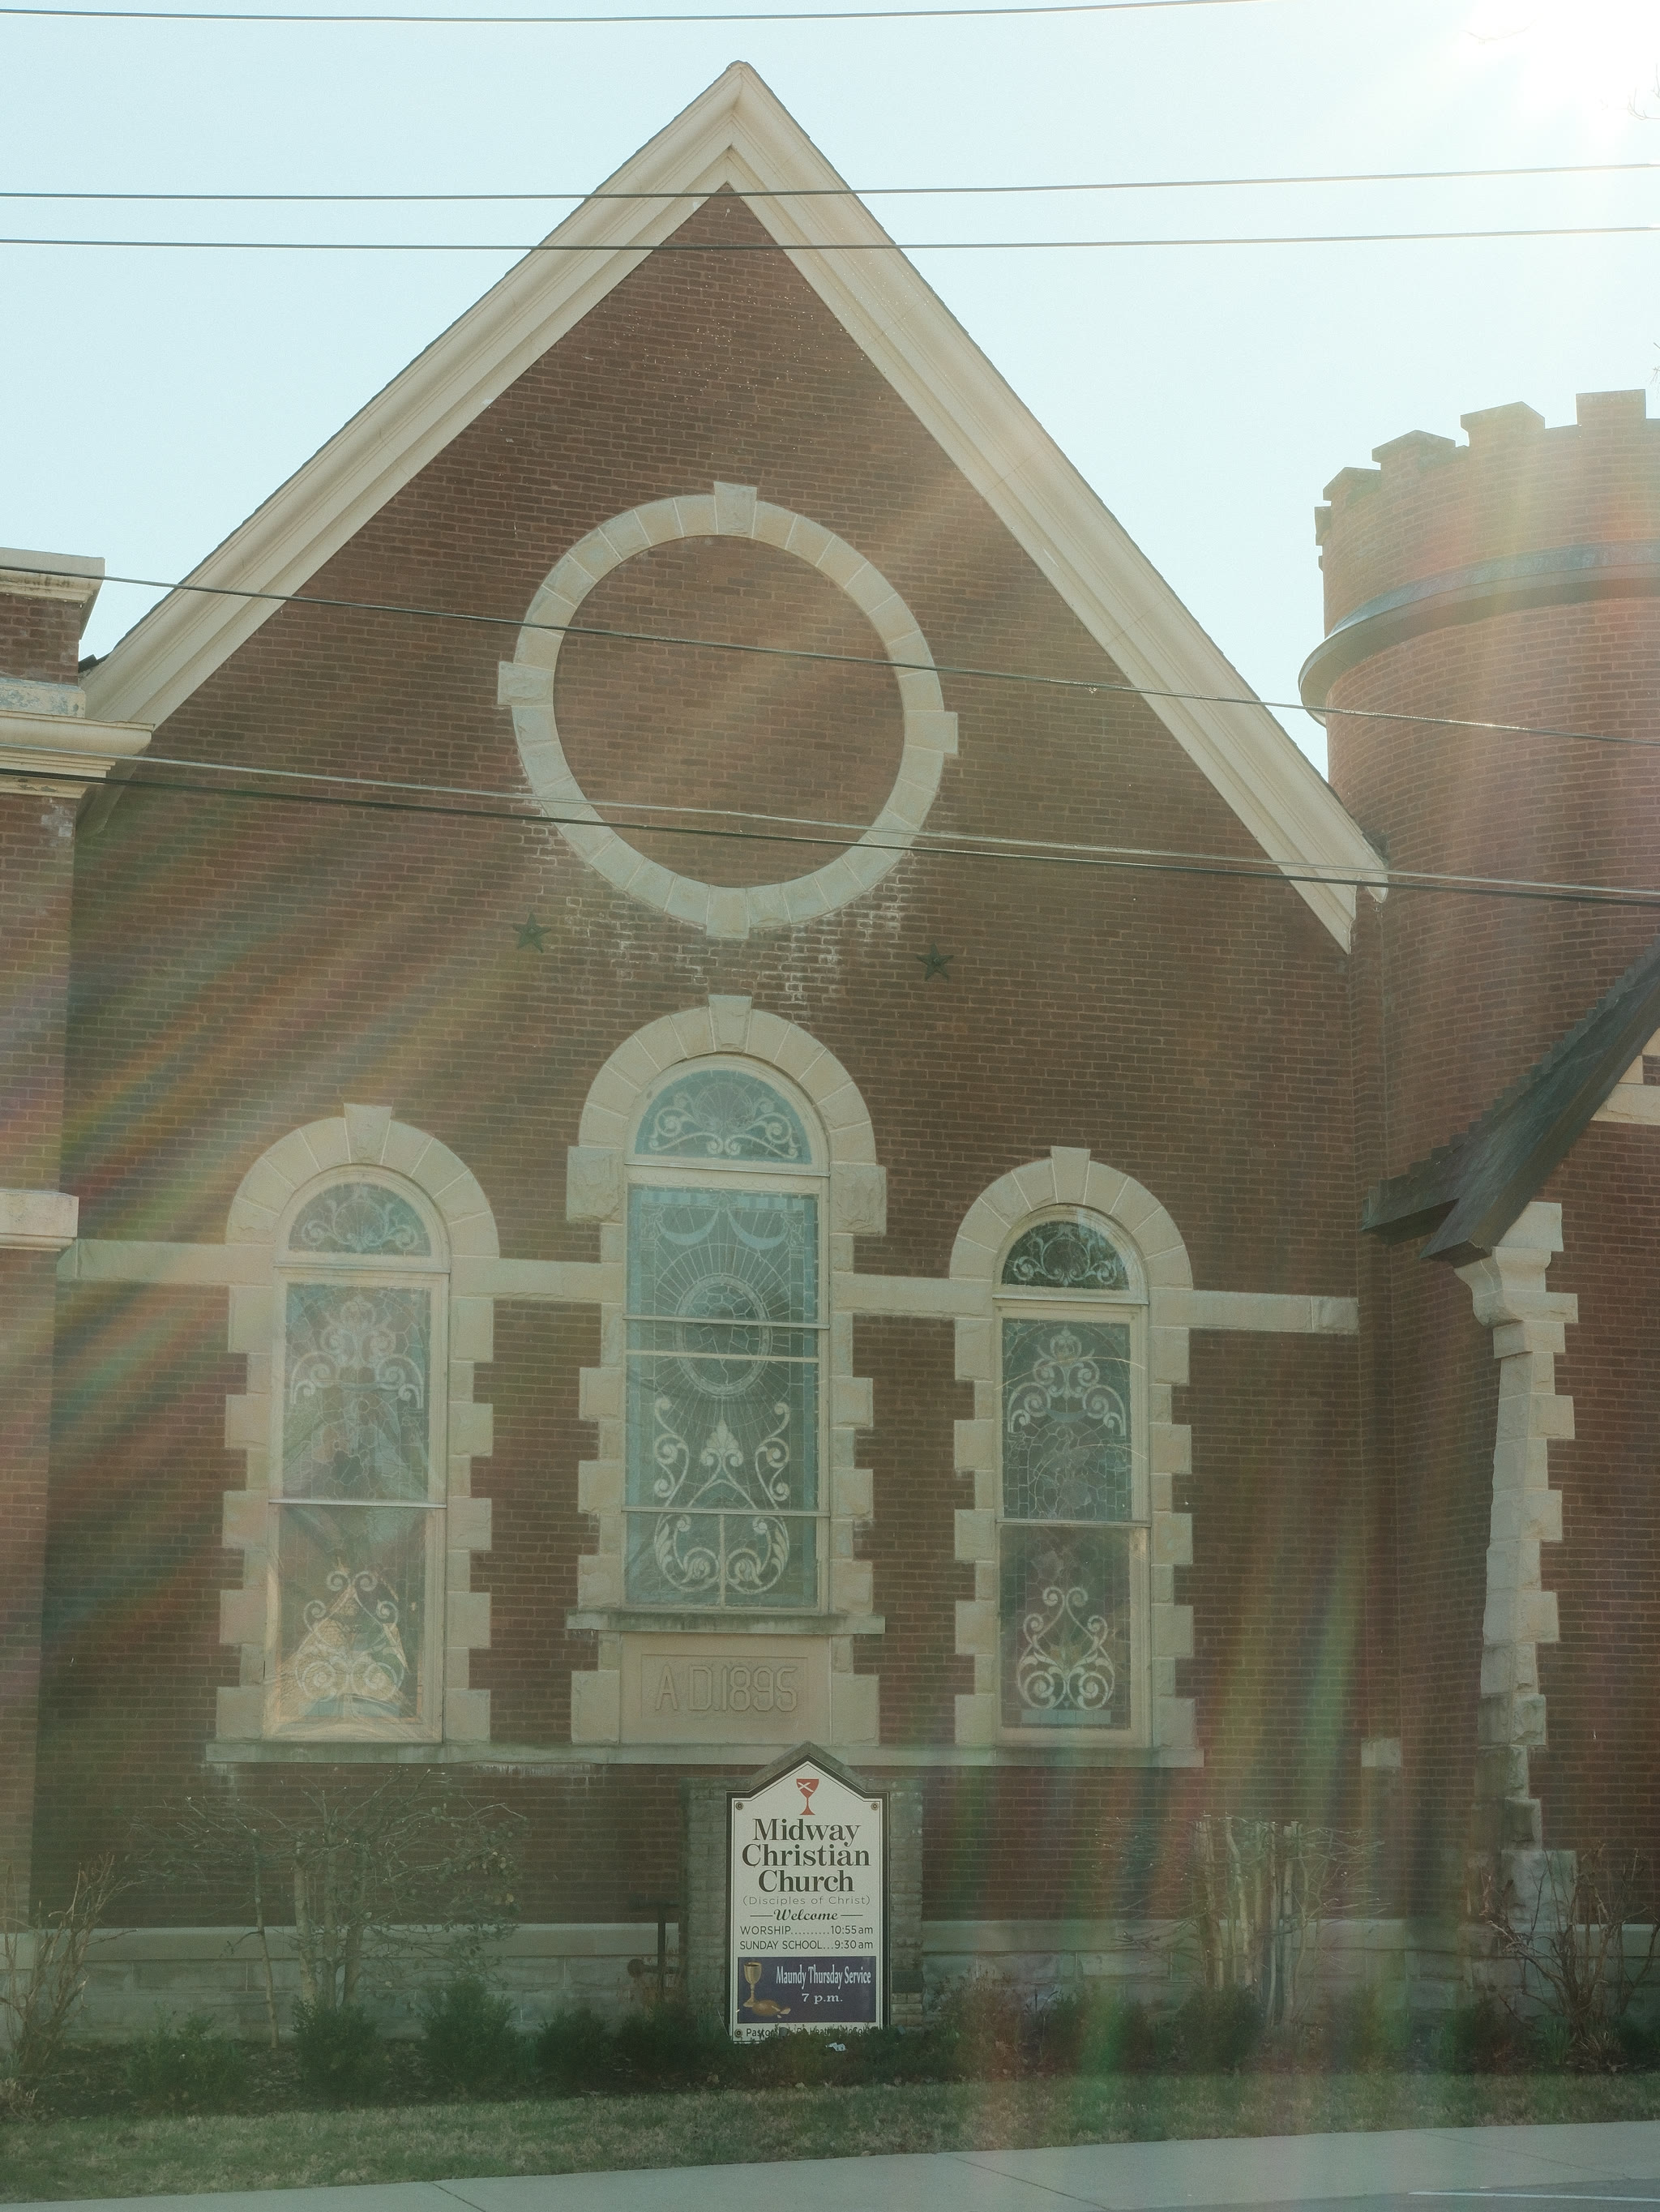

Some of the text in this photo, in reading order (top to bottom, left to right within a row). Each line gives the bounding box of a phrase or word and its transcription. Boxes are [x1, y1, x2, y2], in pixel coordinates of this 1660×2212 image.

[752, 1818, 862, 1847] Midway
[742, 1843, 872, 1867] Christian
[758, 1869, 855, 1893] Church
[742, 1894, 871, 1906] (Disciples of Christ)
[773, 1908, 839, 1921] Welcome
[739, 1940, 779, 1950] SUNDAY
[776, 1964, 871, 1990] Maundy Thursday Service
[801, 1993, 843, 2004] 7 p.m.
